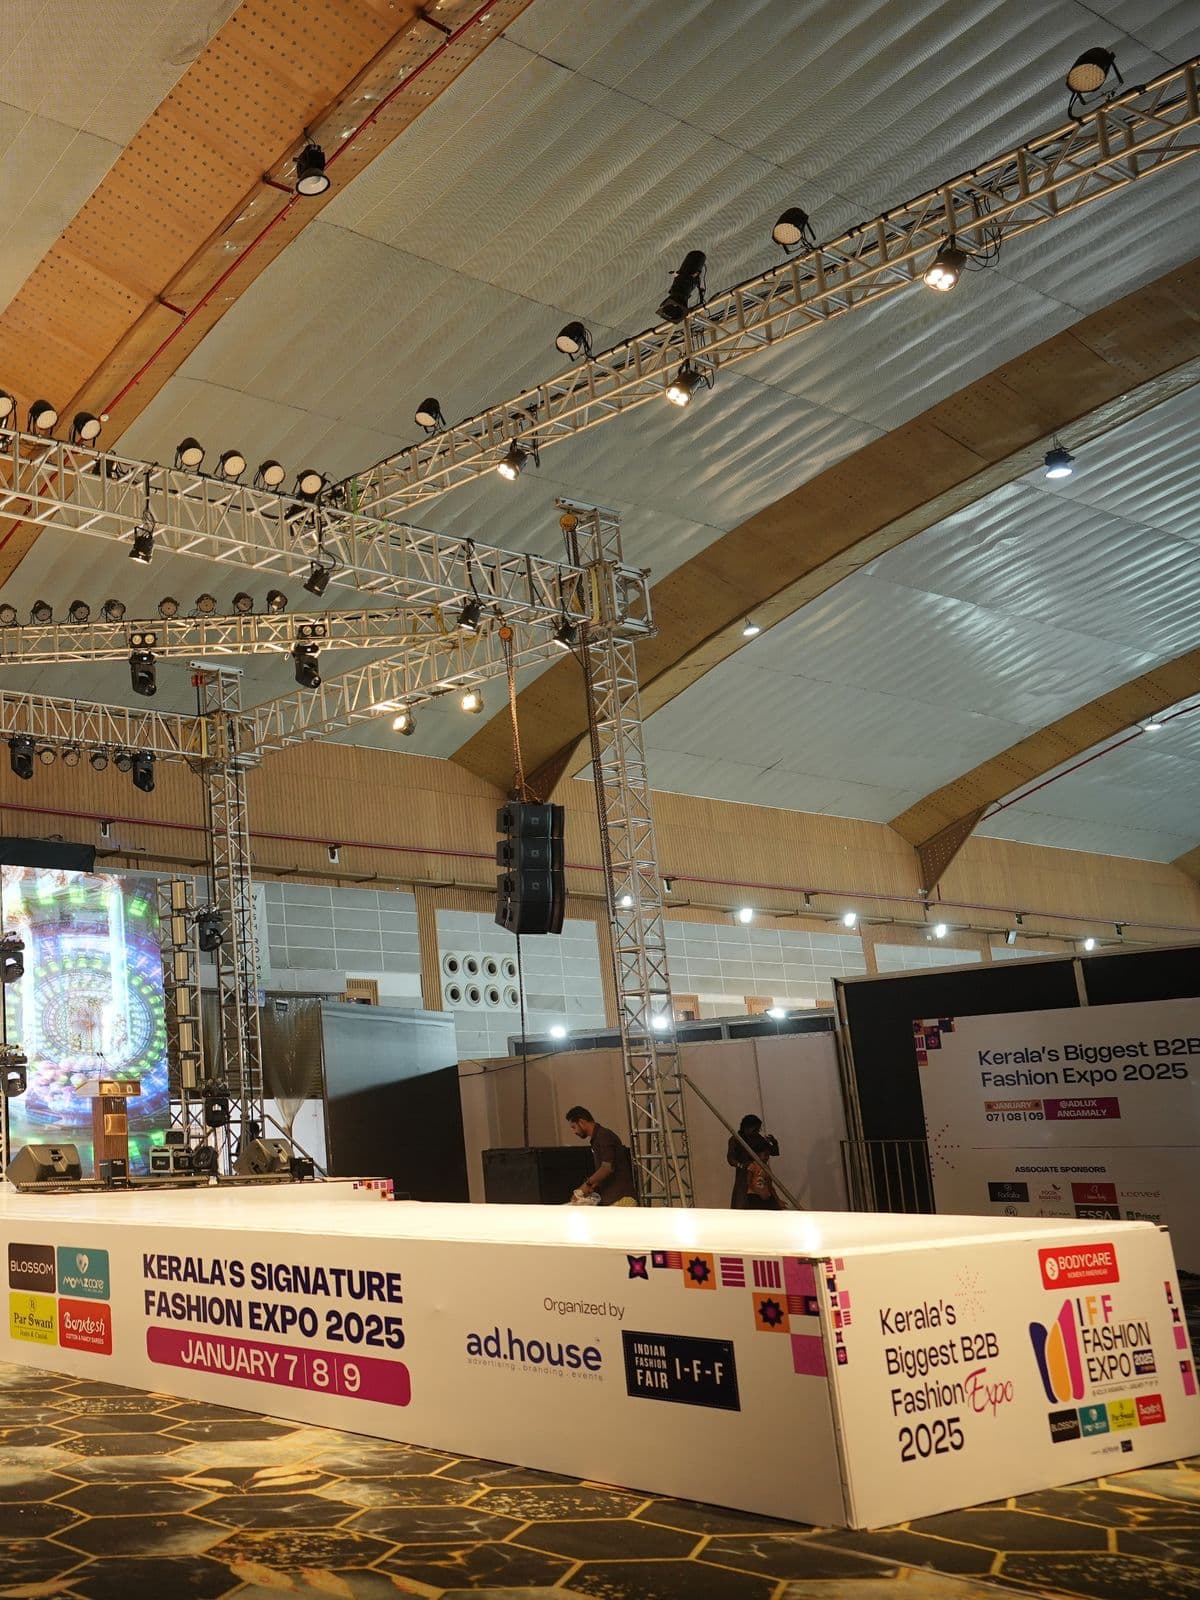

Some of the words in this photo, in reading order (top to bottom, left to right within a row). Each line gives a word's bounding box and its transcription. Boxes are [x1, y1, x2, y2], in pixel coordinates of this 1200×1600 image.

[978, 1046, 1060, 1066] Kerala's
[1063, 1041, 1149, 1064] Biggest
[1153, 1037, 1200, 1057] B2B
[981, 1069, 1059, 1088] Fashion
[1062, 1066, 1118, 1087] Expo
[1122, 1062, 1189, 1082] 2025
[10, 1260, 54, 1276] BLOSSOM
[1058, 1252, 1113, 1270] BODYCARE
[143, 1253, 245, 1288] KERALA'S
[250, 1260, 403, 1304] SIGNATURE
[144, 1289, 243, 1328] FASHION
[248, 1301, 318, 1338] EXPO
[325, 1311, 405, 1350] 2025
[543, 1297, 607, 1316] Organized
[608, 1302, 625, 1321] by
[879, 1299, 957, 1336] Kerala's
[633, 1342, 666, 1357] INDIAN
[1081, 1321, 1152, 1354] FASHION
[180, 1339, 279, 1379] JANUARY
[283, 1354, 299, 1382] 7
[312, 1359, 330, 1387] 8
[343, 1363, 361, 1393] 9
[467, 1357, 516, 1371] advertising
[522, 1363, 564, 1377] branding
[635, 1356, 667, 1369] FASHION
[885, 1339, 959, 1379] Biggest
[960, 1332, 999, 1362] B2B
[1086, 1352, 1132, 1383] EXPO
[636, 1369, 669, 1389] FAIR
[890, 1380, 965, 1417] Fashion
[964, 1367, 1013, 1418] Expo
[898, 1416, 965, 1463] 2025
